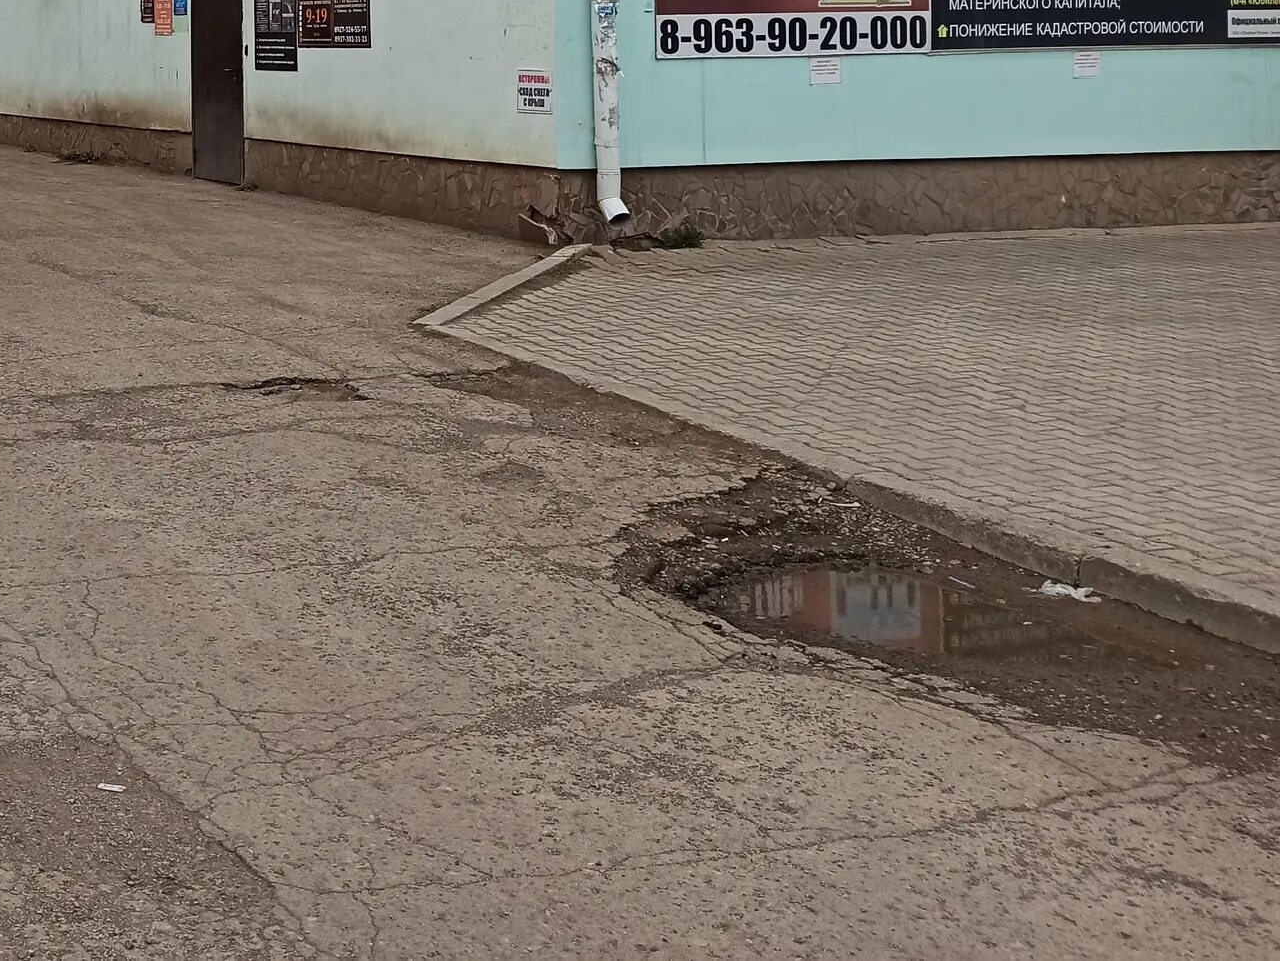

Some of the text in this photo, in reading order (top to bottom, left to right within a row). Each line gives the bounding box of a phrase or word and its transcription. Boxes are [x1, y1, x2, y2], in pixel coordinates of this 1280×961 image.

[305, 8, 328, 23] 9-19
[659, 15, 927, 54] 8-963-90-20-000
[949, 19, 1204, 38] ПОНИЖЕНИЕ КАДАСТРОВОЙ СТОИМОСТИ
